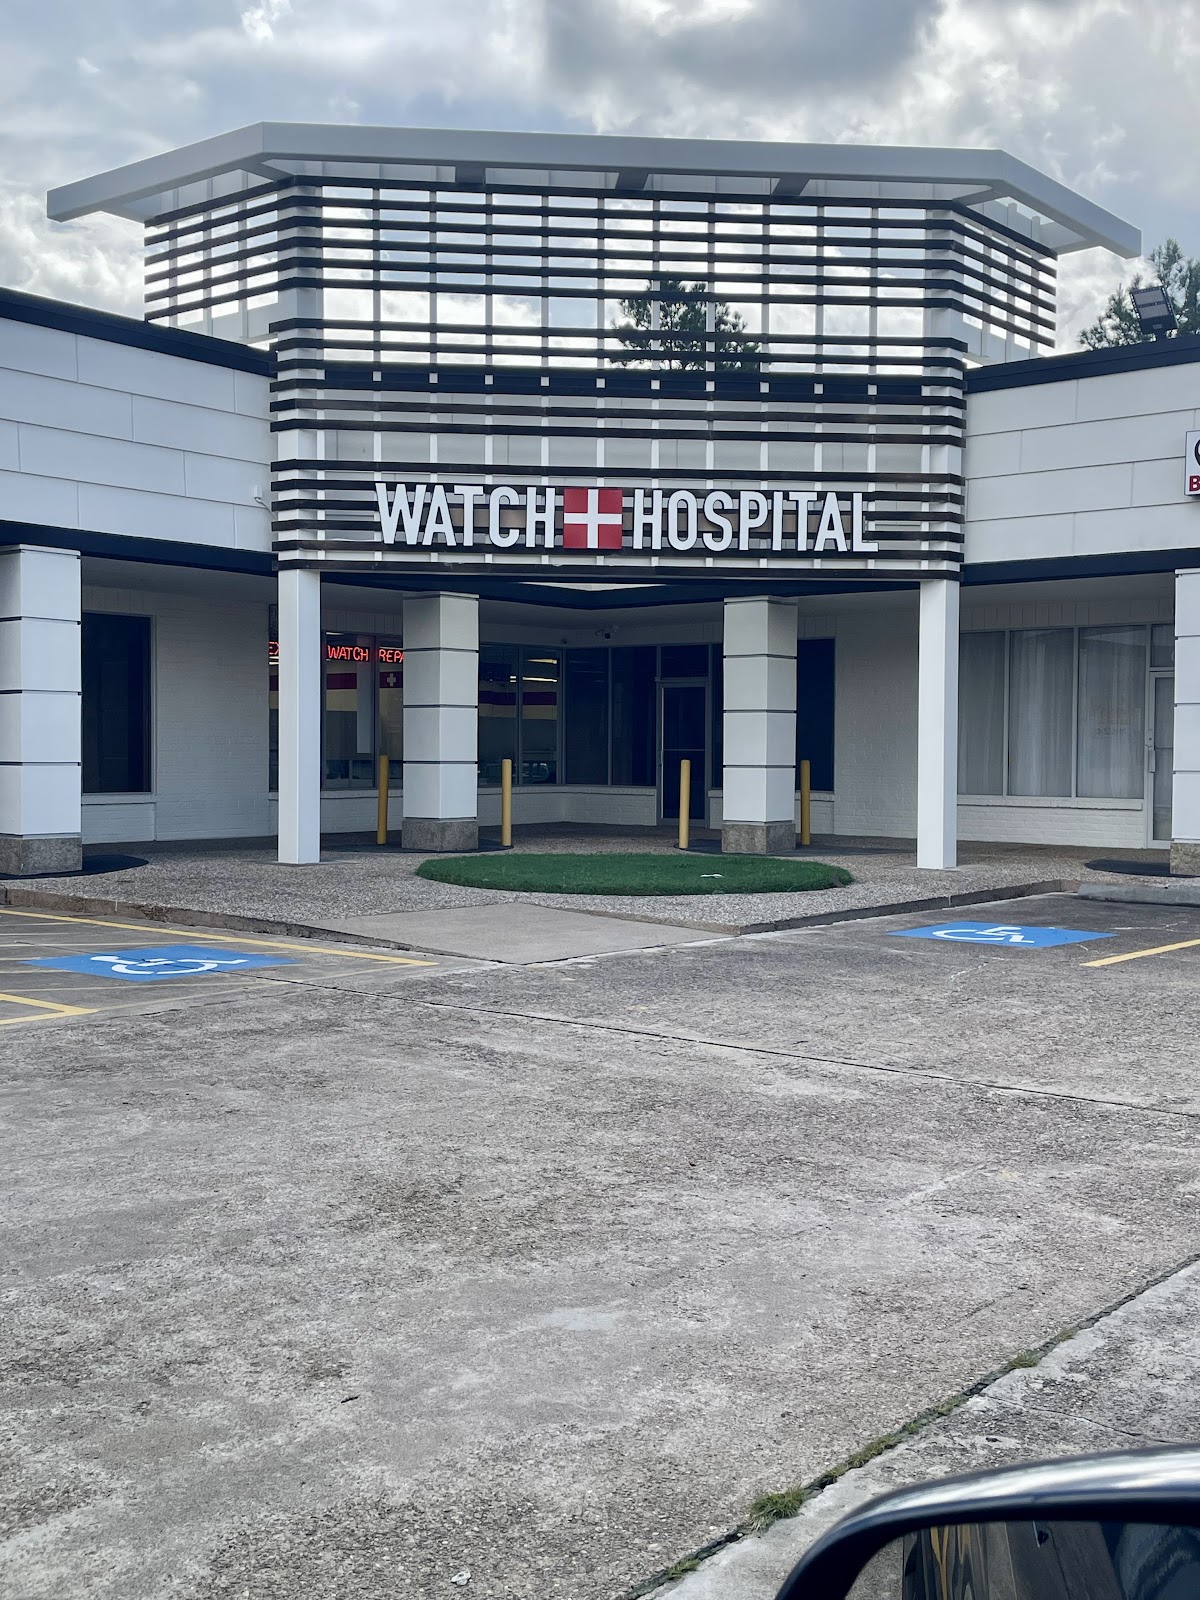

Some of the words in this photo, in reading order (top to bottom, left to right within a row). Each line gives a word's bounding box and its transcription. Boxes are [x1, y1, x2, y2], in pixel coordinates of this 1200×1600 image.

[375, 482, 556, 549] WATCH
[632, 488, 879, 552] HOSPITAL
[327, 645, 369, 662] WATCH
